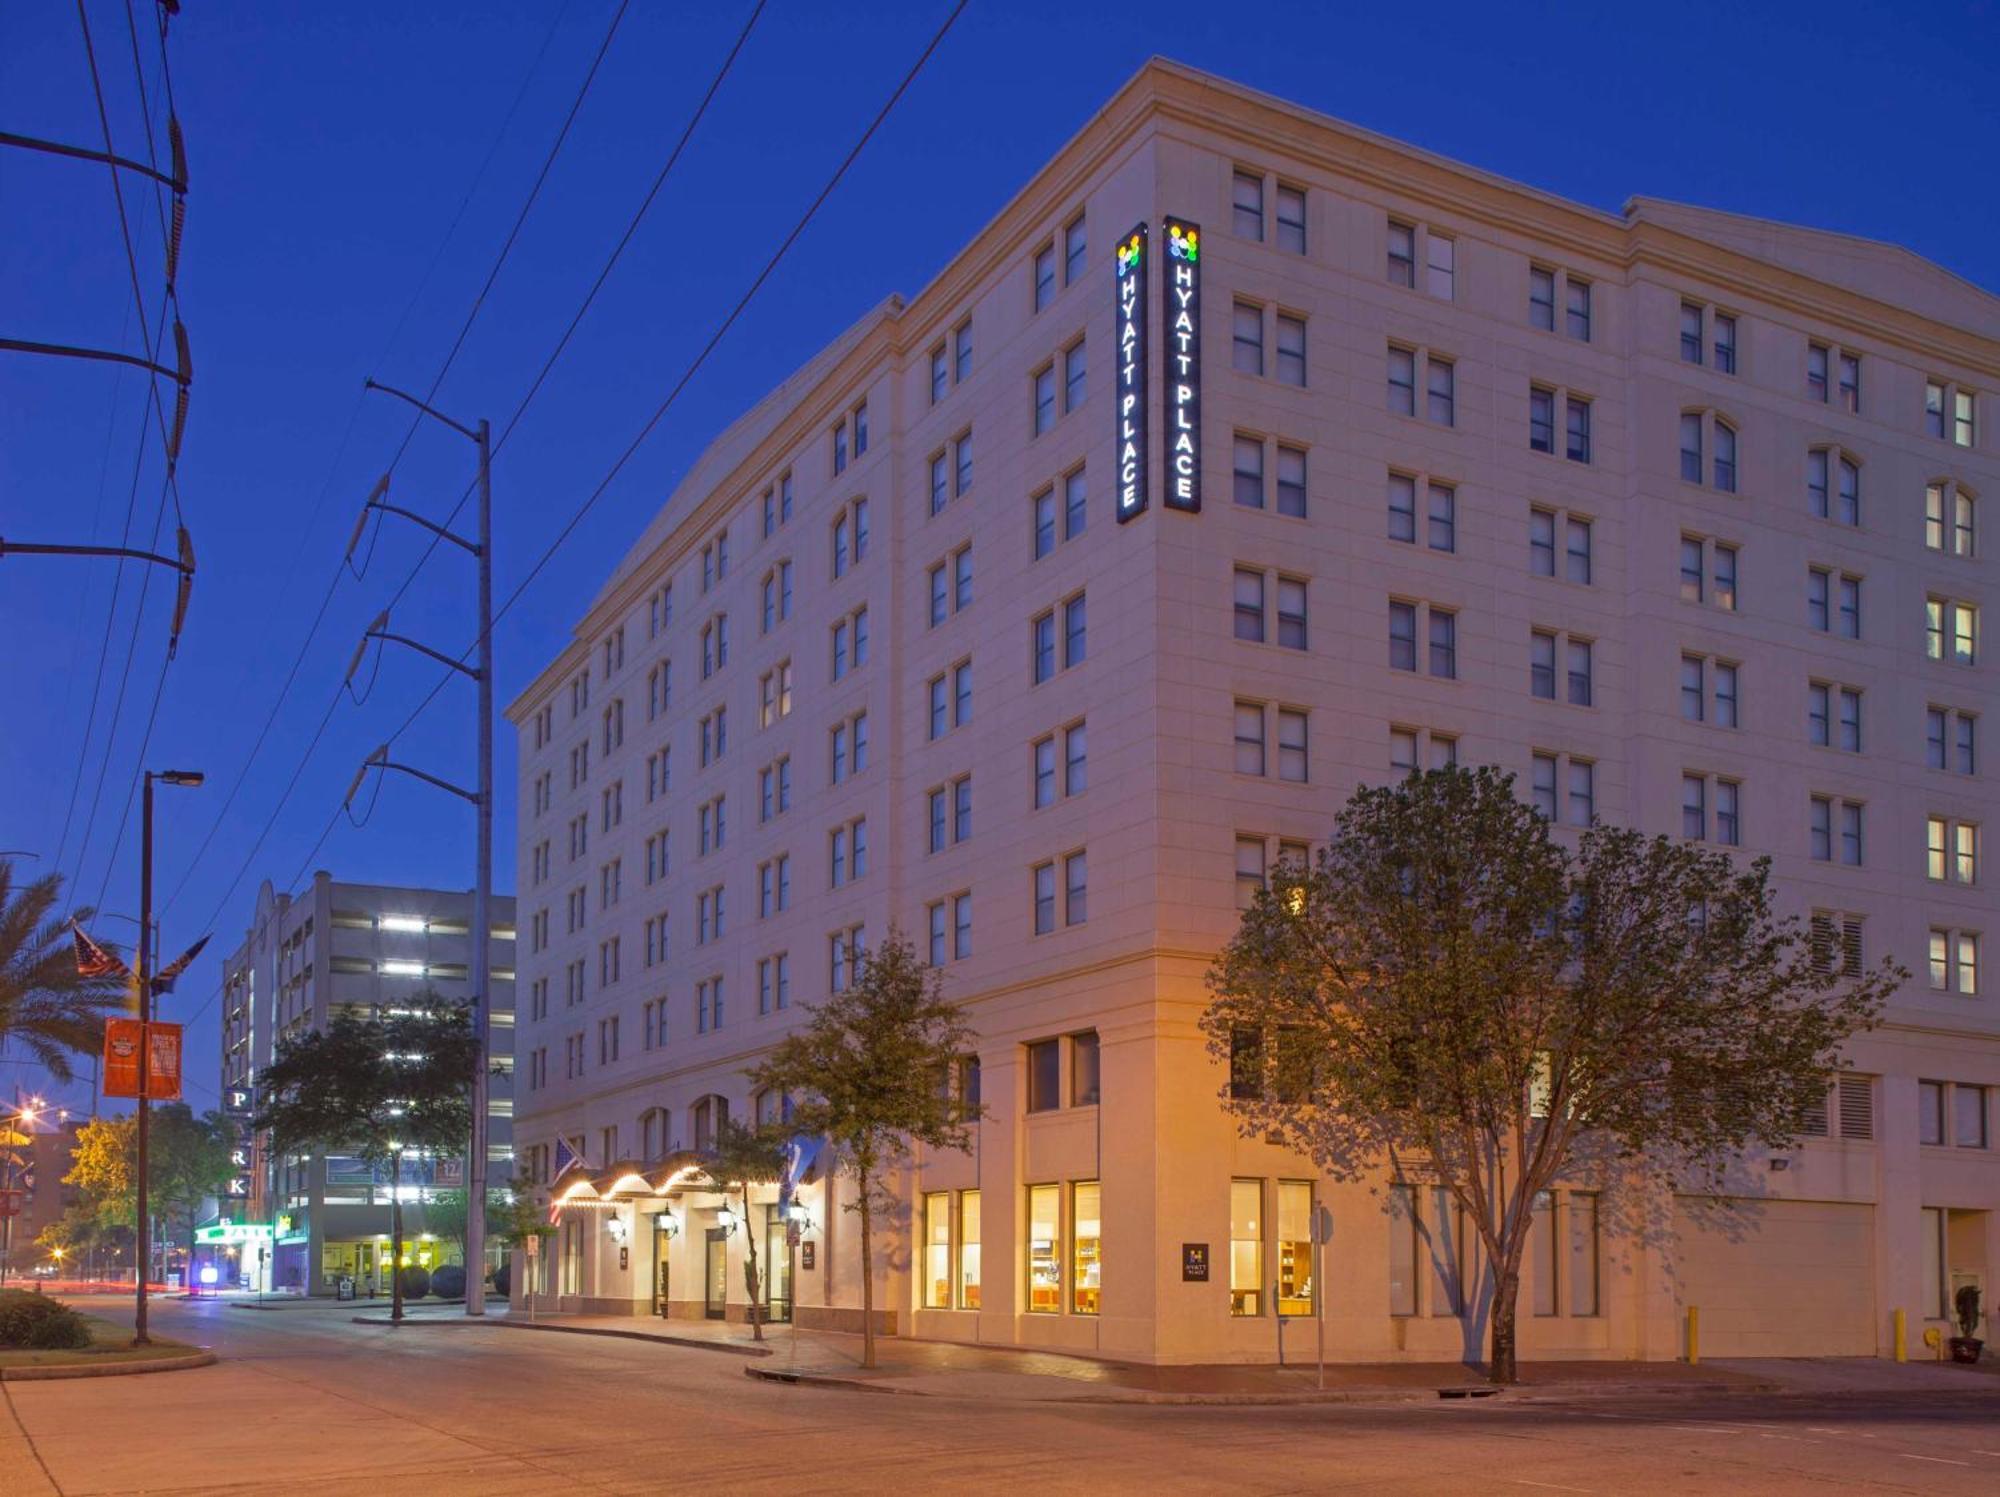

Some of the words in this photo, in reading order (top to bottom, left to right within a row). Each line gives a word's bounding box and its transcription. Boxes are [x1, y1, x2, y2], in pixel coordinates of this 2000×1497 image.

[1122, 275, 1136, 384] HYATT
[1175, 265, 1193, 375] HYATT
[1122, 394, 1136, 508] PLACE
[1175, 385, 1193, 498] PLACE
